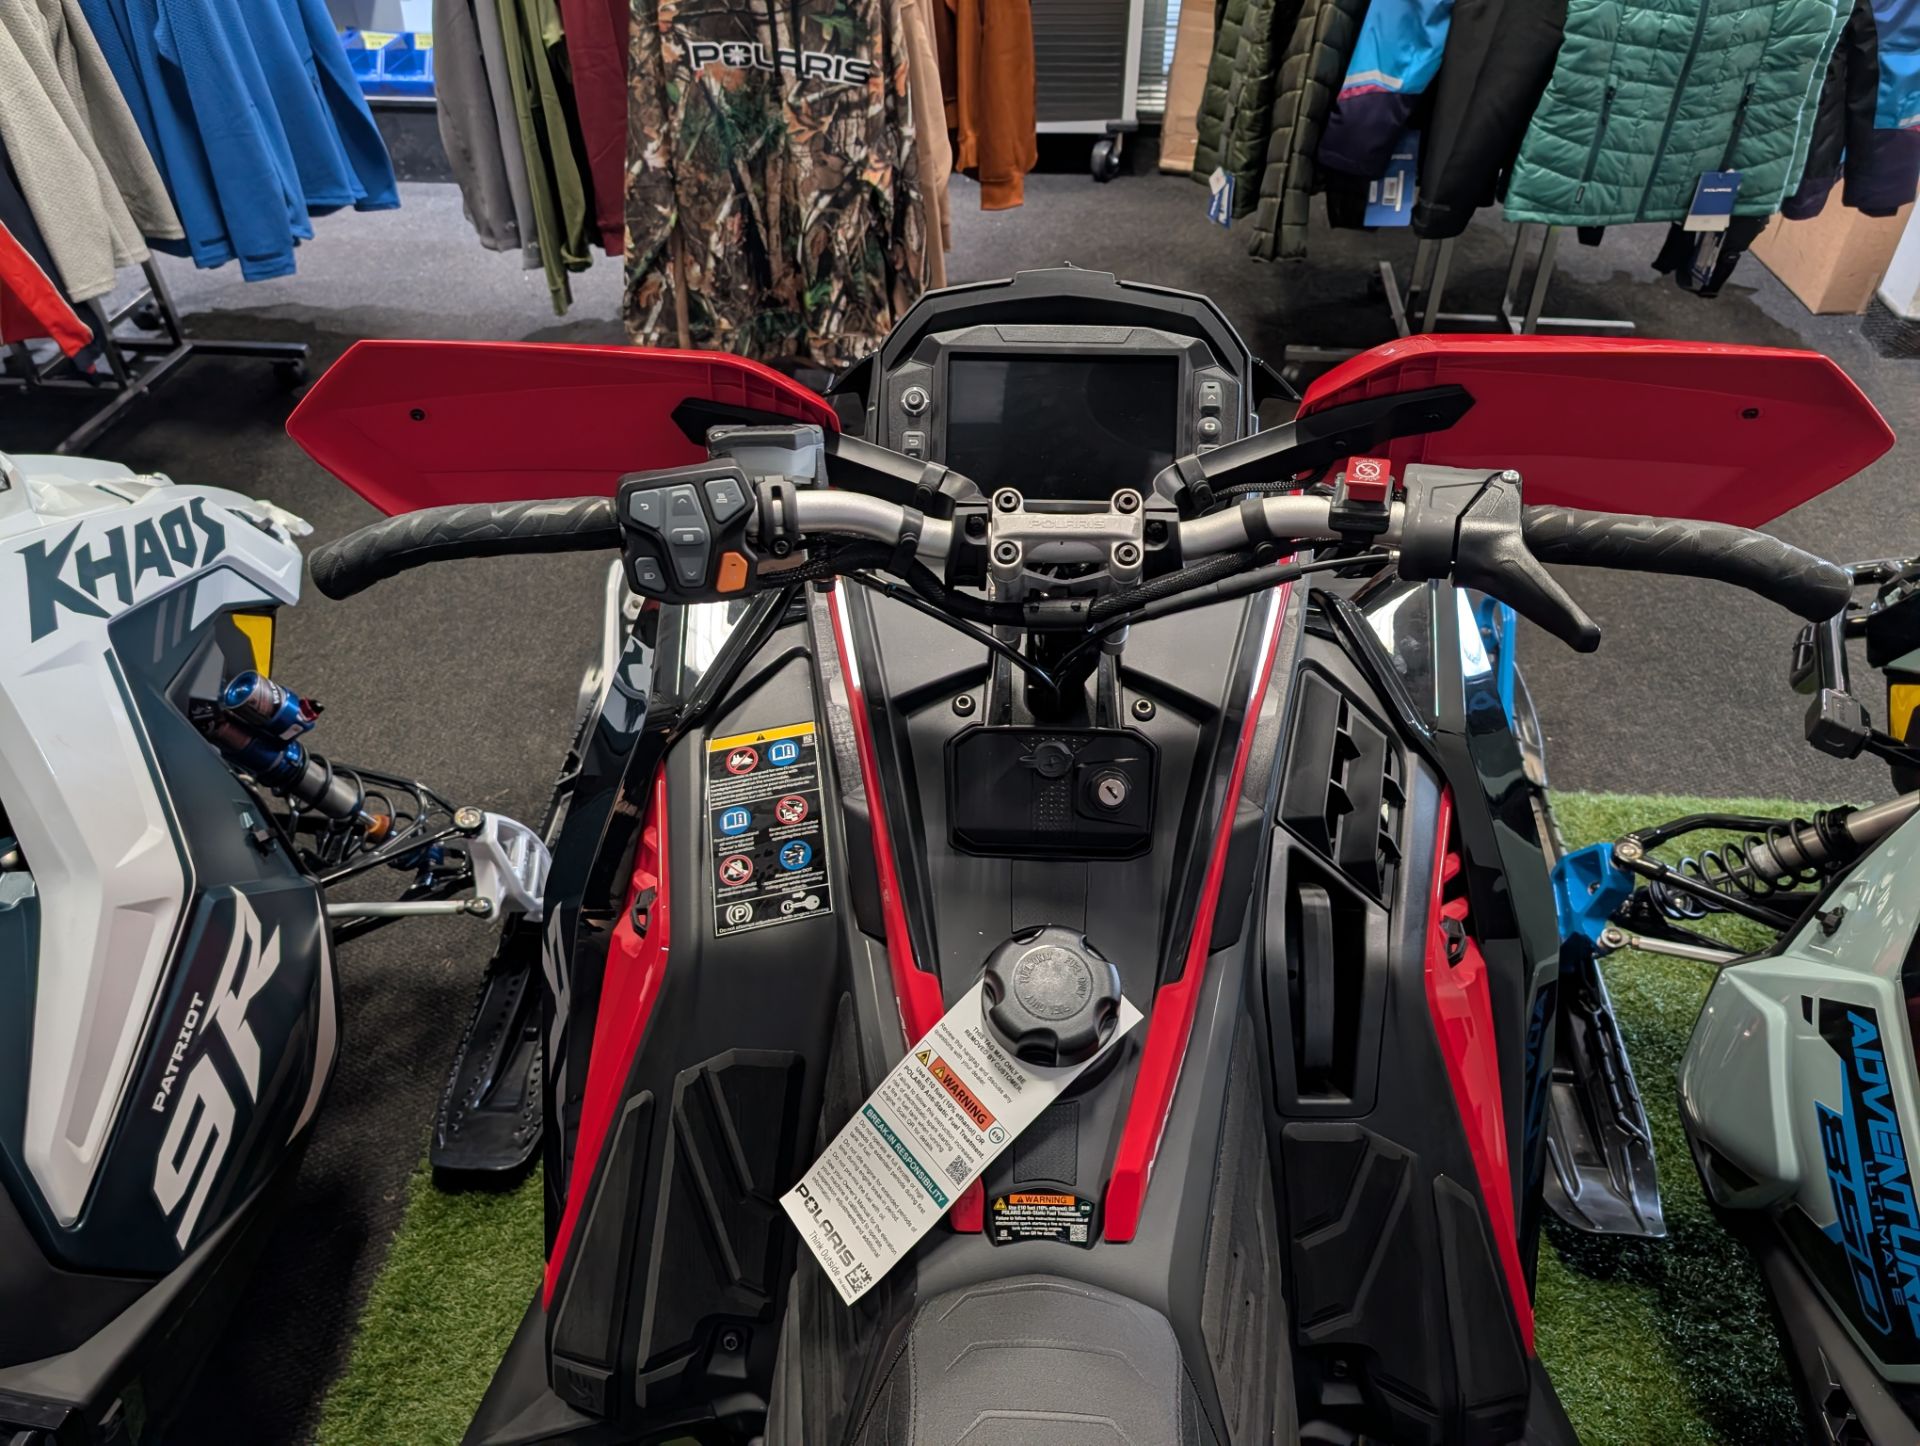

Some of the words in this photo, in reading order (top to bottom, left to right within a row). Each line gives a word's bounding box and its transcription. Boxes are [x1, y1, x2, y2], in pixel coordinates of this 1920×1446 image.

[690, 41, 872, 86] POLARIS
[1029, 519, 1106, 529] POLARIS
[14, 496, 226, 643] KHAOS
[152, 991, 204, 1113] PATRIOT
[933, 1028, 954, 1051] questions
[952, 1048, 963, 1060] with
[960, 1059, 972, 1071] your
[939, 1022, 955, 1040] Review
[954, 1038, 964, 1049] this
[960, 1047, 980, 1068] hangtag
[978, 1065, 989, 1077] and
[986, 1074, 1004, 1094] discuss
[1001, 1093, 1012, 1104] any
[963, 1028, 989, 1056] REMOVED
[986, 1053, 996, 1064] BY
[993, 1061, 1024, 1094] CUSTOMER.
[982, 1037, 995, 1051] TAG
[992, 1048, 1006, 1062] MAY
[1003, 1059, 1019, 1076] ONLY
[1016, 1074, 1026, 1084] BE
[896, 1072, 912, 1090] Failure
[914, 1093, 928, 1108] follow
[925, 1106, 935, 1117] this
[933, 1115, 954, 1138] instruction
[953, 1138, 975, 1163] increases
[903, 1064, 925, 1090] POLARIS
[923, 1088, 949, 1118] Anti-Static
[947, 1116, 960, 1130] Fuel
[958, 1129, 985, 1160] Treatment.
[915, 1066, 926, 1079] Use
[924, 1076, 935, 1089] E10
[933, 1087, 945, 1100] fuel
[942, 1098, 957, 1114] (10%
[953, 1111, 976, 1137] ethanol)
[974, 1134, 985, 1145] OR
[941, 1074, 987, 1125] WARNING
[990, 1130, 1001, 1141] E10
[866, 1108, 896, 1144] BREAK-IN
[893, 1142, 944, 1203] RESPONSIBILITY
[794, 1181, 855, 1268] POLARIS
[808, 1229, 824, 1250] Think
[820, 1247, 842, 1276] Outside
[1864, 1160, 1905, 1306] ULTIMATE
